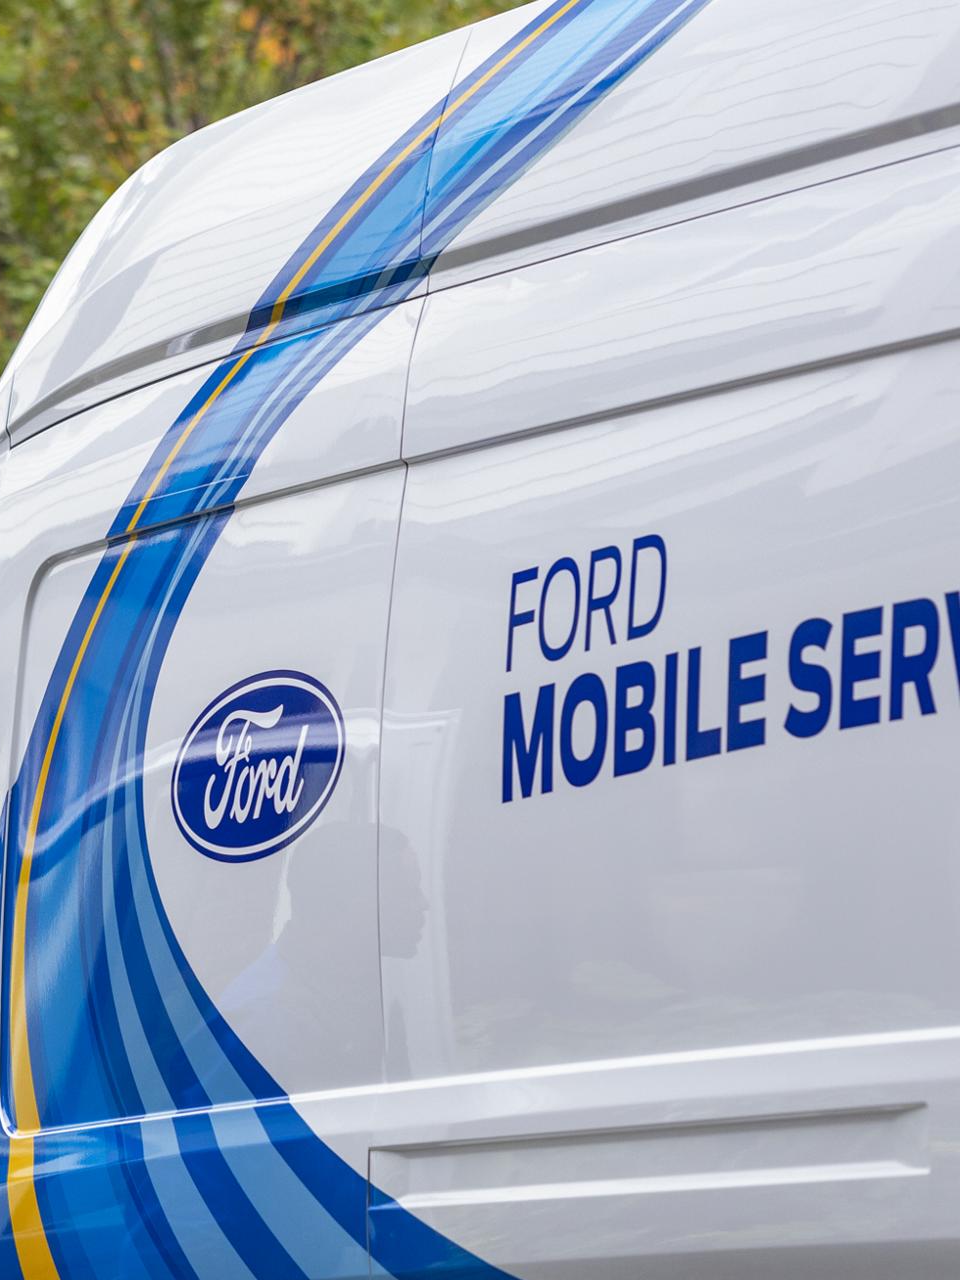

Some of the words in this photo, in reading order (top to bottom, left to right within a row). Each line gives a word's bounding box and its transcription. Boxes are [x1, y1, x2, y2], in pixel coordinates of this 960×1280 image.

[506, 534, 667, 672] FORD
[203, 703, 309, 829] Ford
[501, 630, 768, 803] MOBILE
